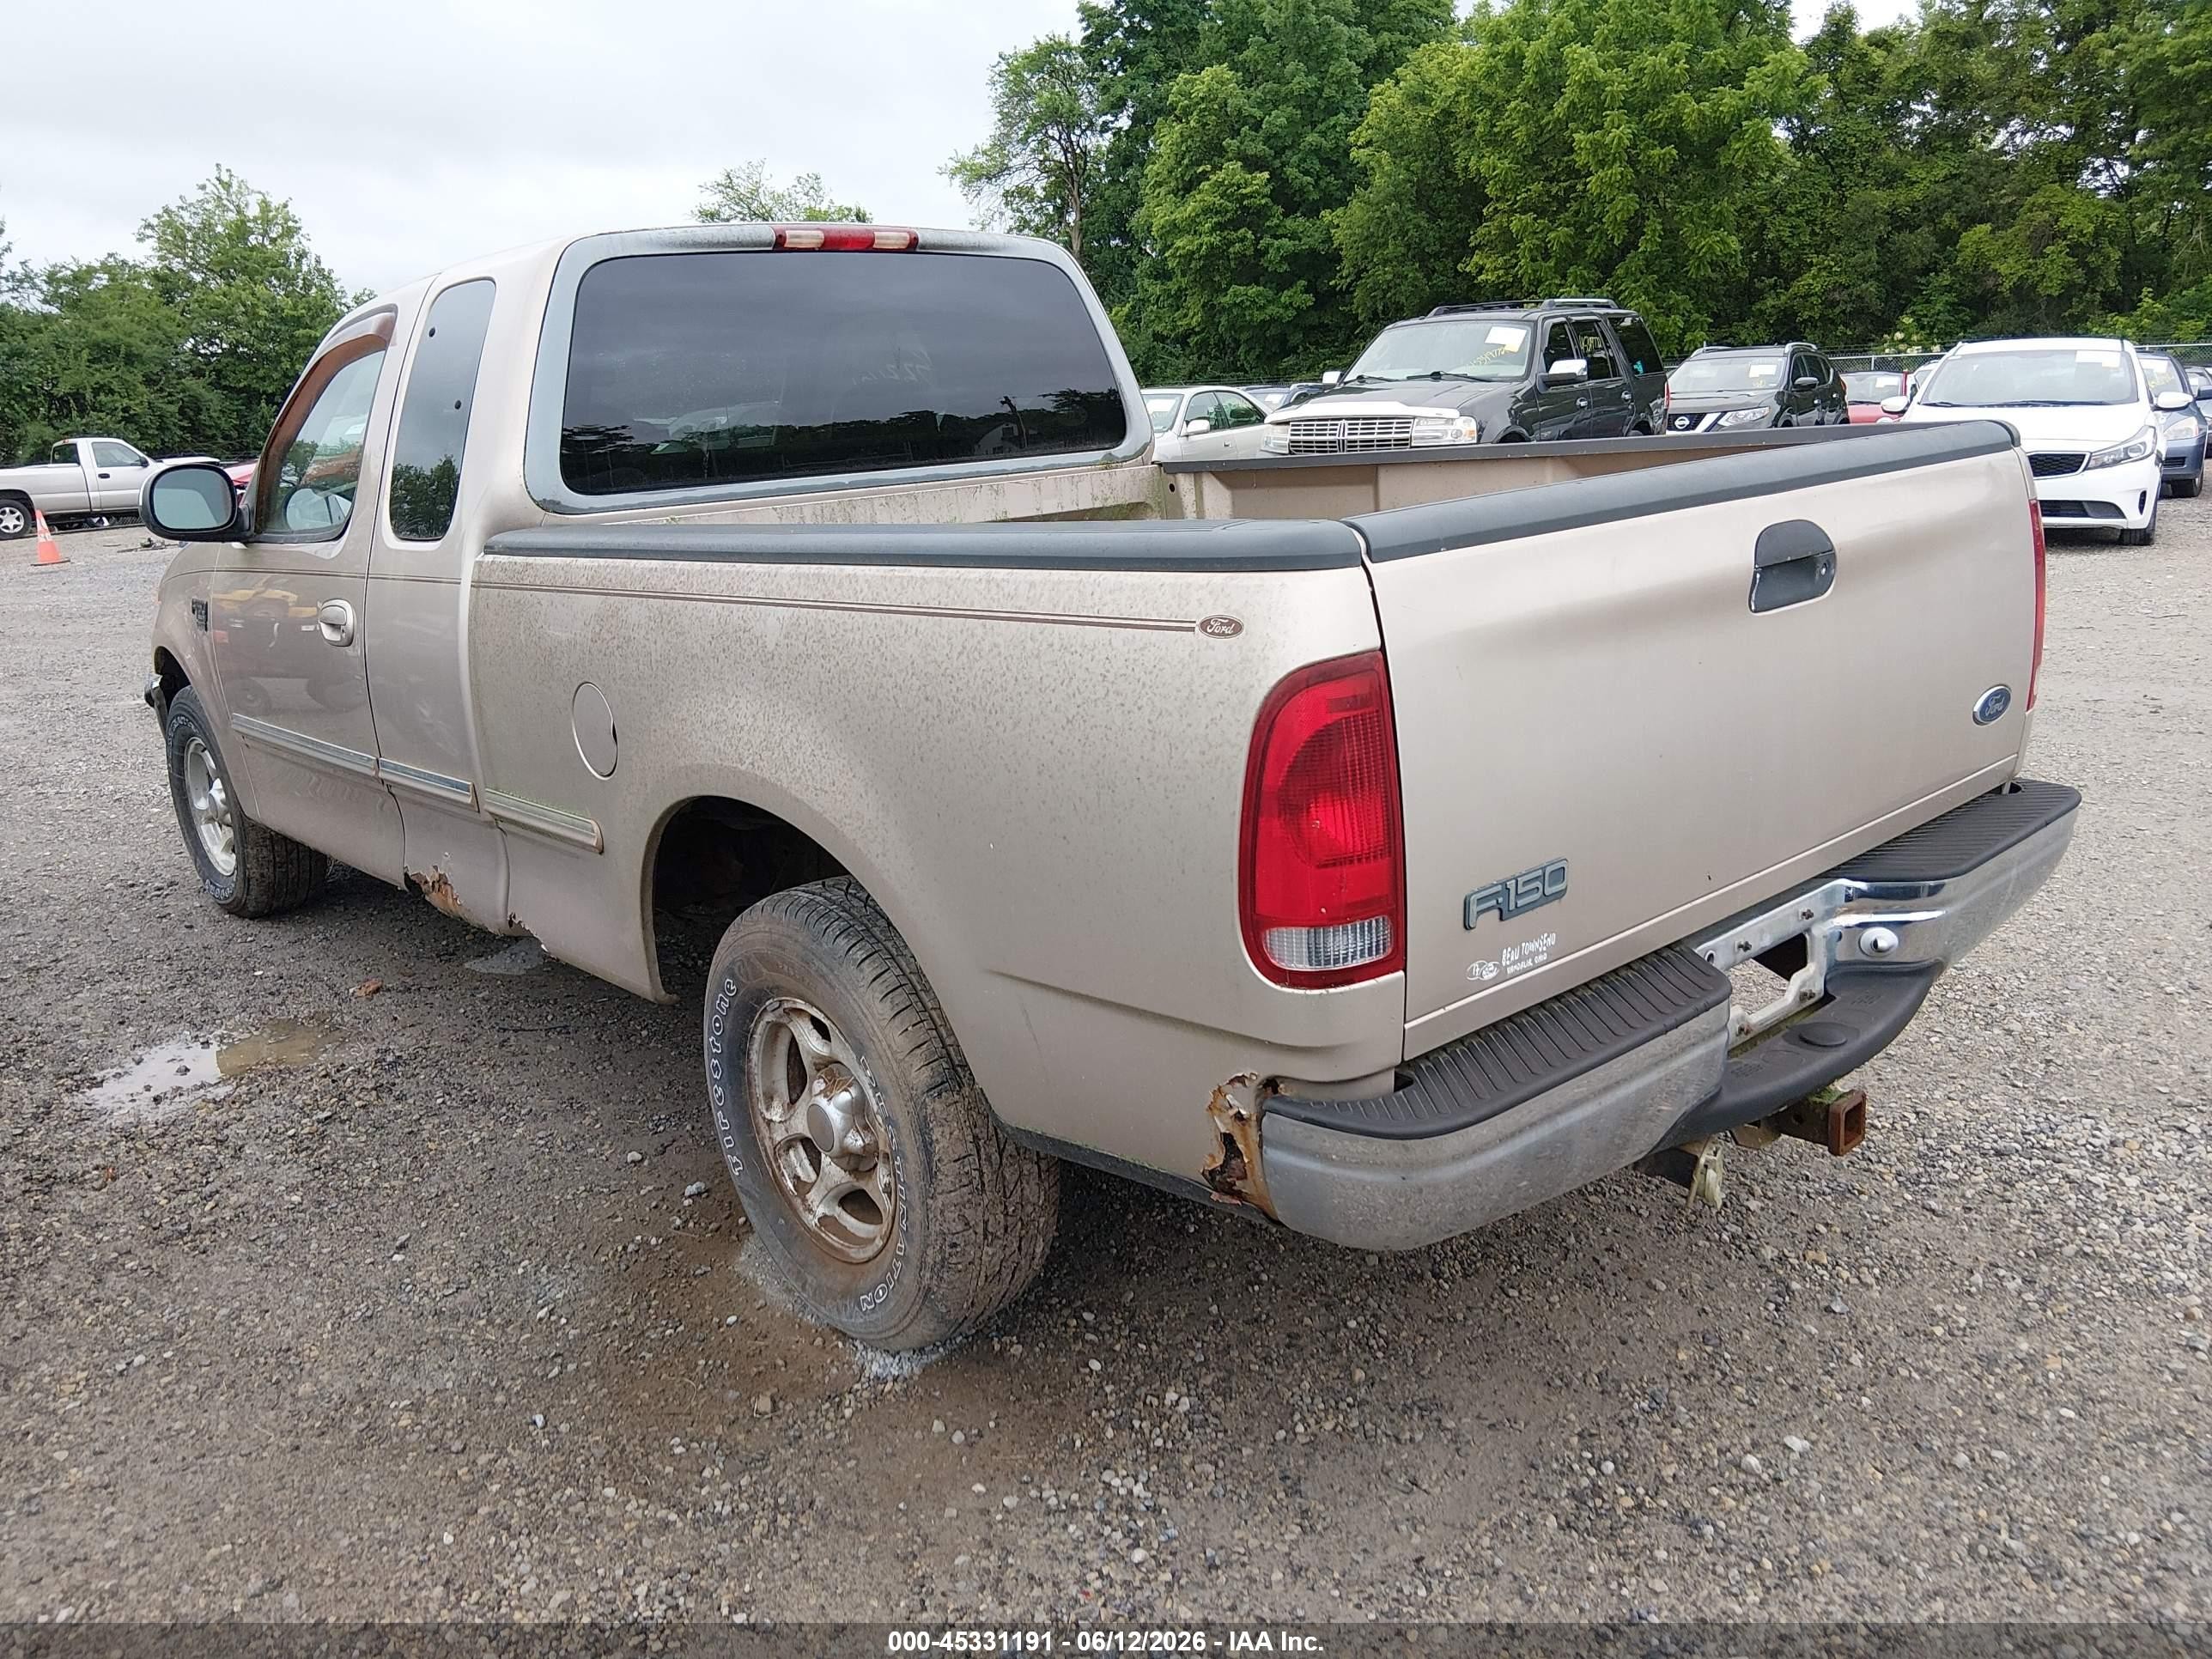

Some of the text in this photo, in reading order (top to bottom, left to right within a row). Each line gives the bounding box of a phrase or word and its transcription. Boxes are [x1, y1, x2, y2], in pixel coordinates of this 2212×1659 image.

[1206, 617, 1236, 635] Ford
[1467, 860, 1569, 931] F-150
[1501, 933, 1556, 967] BEAU TOWNSEND
[708, 977, 744, 1176] Firestone
[859, 1055, 908, 1313] DESTINATION
